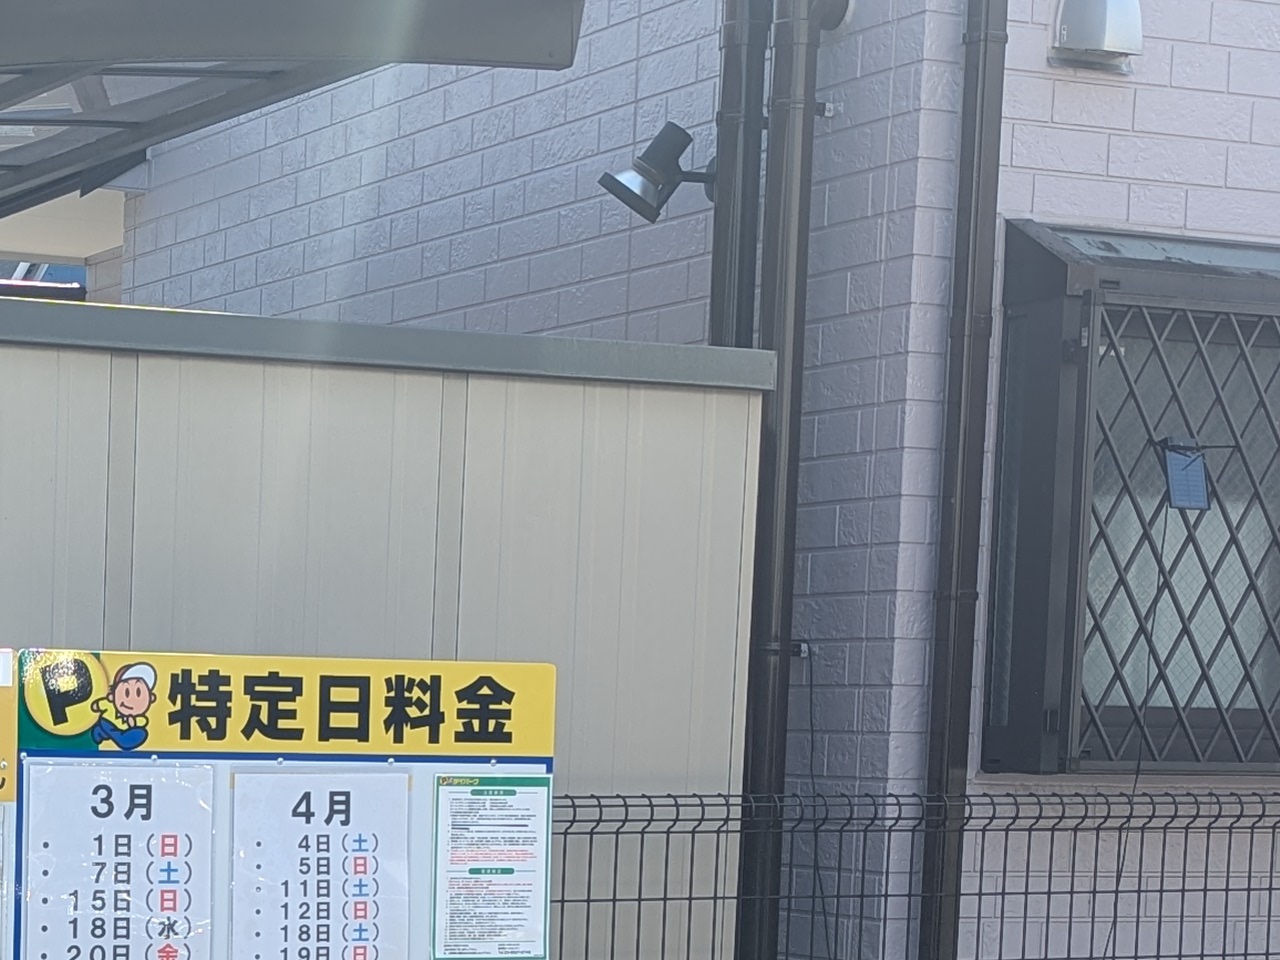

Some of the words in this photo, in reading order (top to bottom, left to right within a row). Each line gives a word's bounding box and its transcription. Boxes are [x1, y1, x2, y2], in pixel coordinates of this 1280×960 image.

[168, 667, 516, 745] 特定日料金
[91, 784, 152, 820] 3月
[292, 791, 351, 826] 4月
